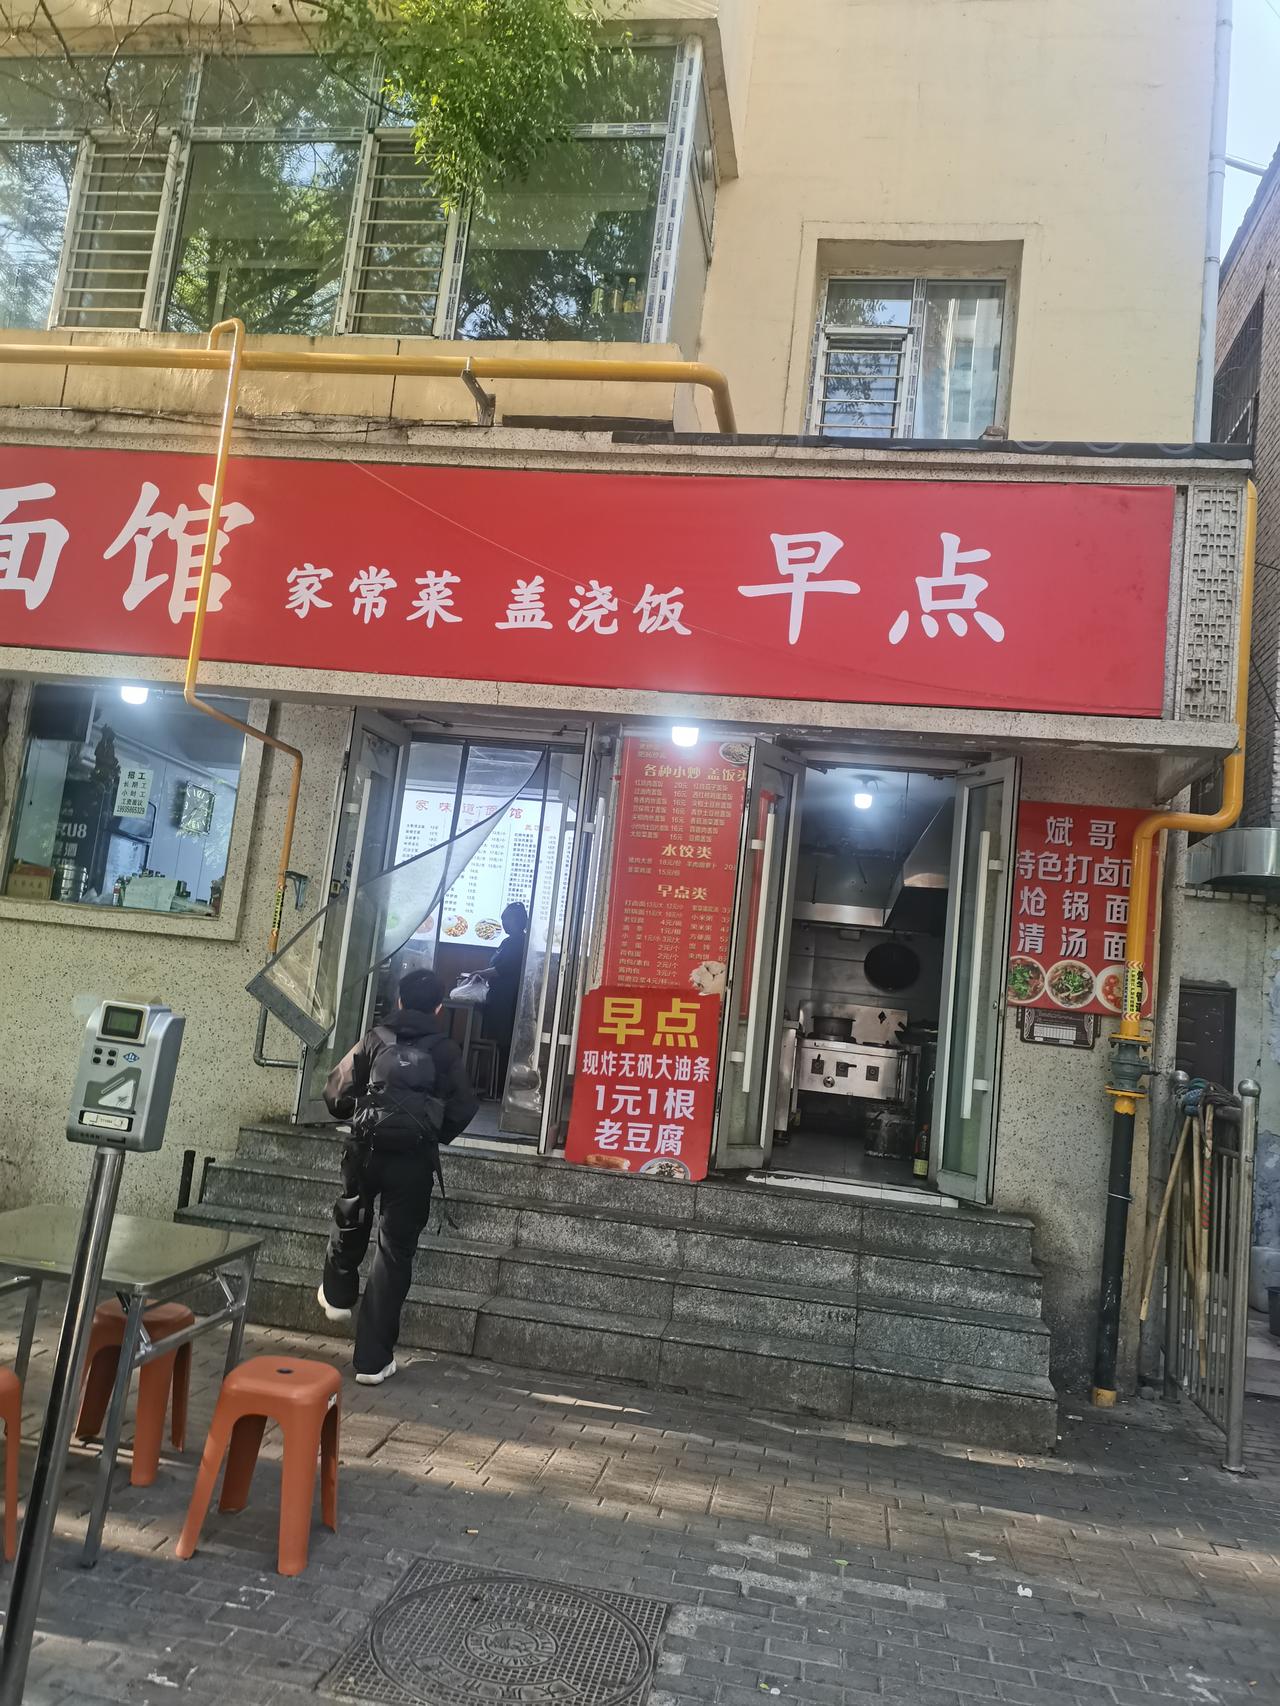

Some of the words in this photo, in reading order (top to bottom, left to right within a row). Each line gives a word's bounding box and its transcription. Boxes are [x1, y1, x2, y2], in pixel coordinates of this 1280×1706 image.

[0, 480, 255, 624] 面馆
[284, 562, 463, 628] 家常菜
[495, 574, 692, 637] 盖浇饭
[737, 530, 1006, 645] 早点
[128, 771, 146, 780] 招工
[644, 763, 701, 779] 各种小炒
[1045, 816, 1117, 850] 斌哥
[662, 844, 712, 859] 水饺类
[657, 884, 709, 900] 早点类
[1018, 886, 1130, 925] 炝锅面
[1017, 922, 1127, 962] 清汤面
[598, 996, 701, 1048] 早点
[582, 1050, 712, 1083] 现炸无矾大油条
[595, 1085, 695, 1120] 1元1根
[594, 1119, 685, 1156] 老豆腐
